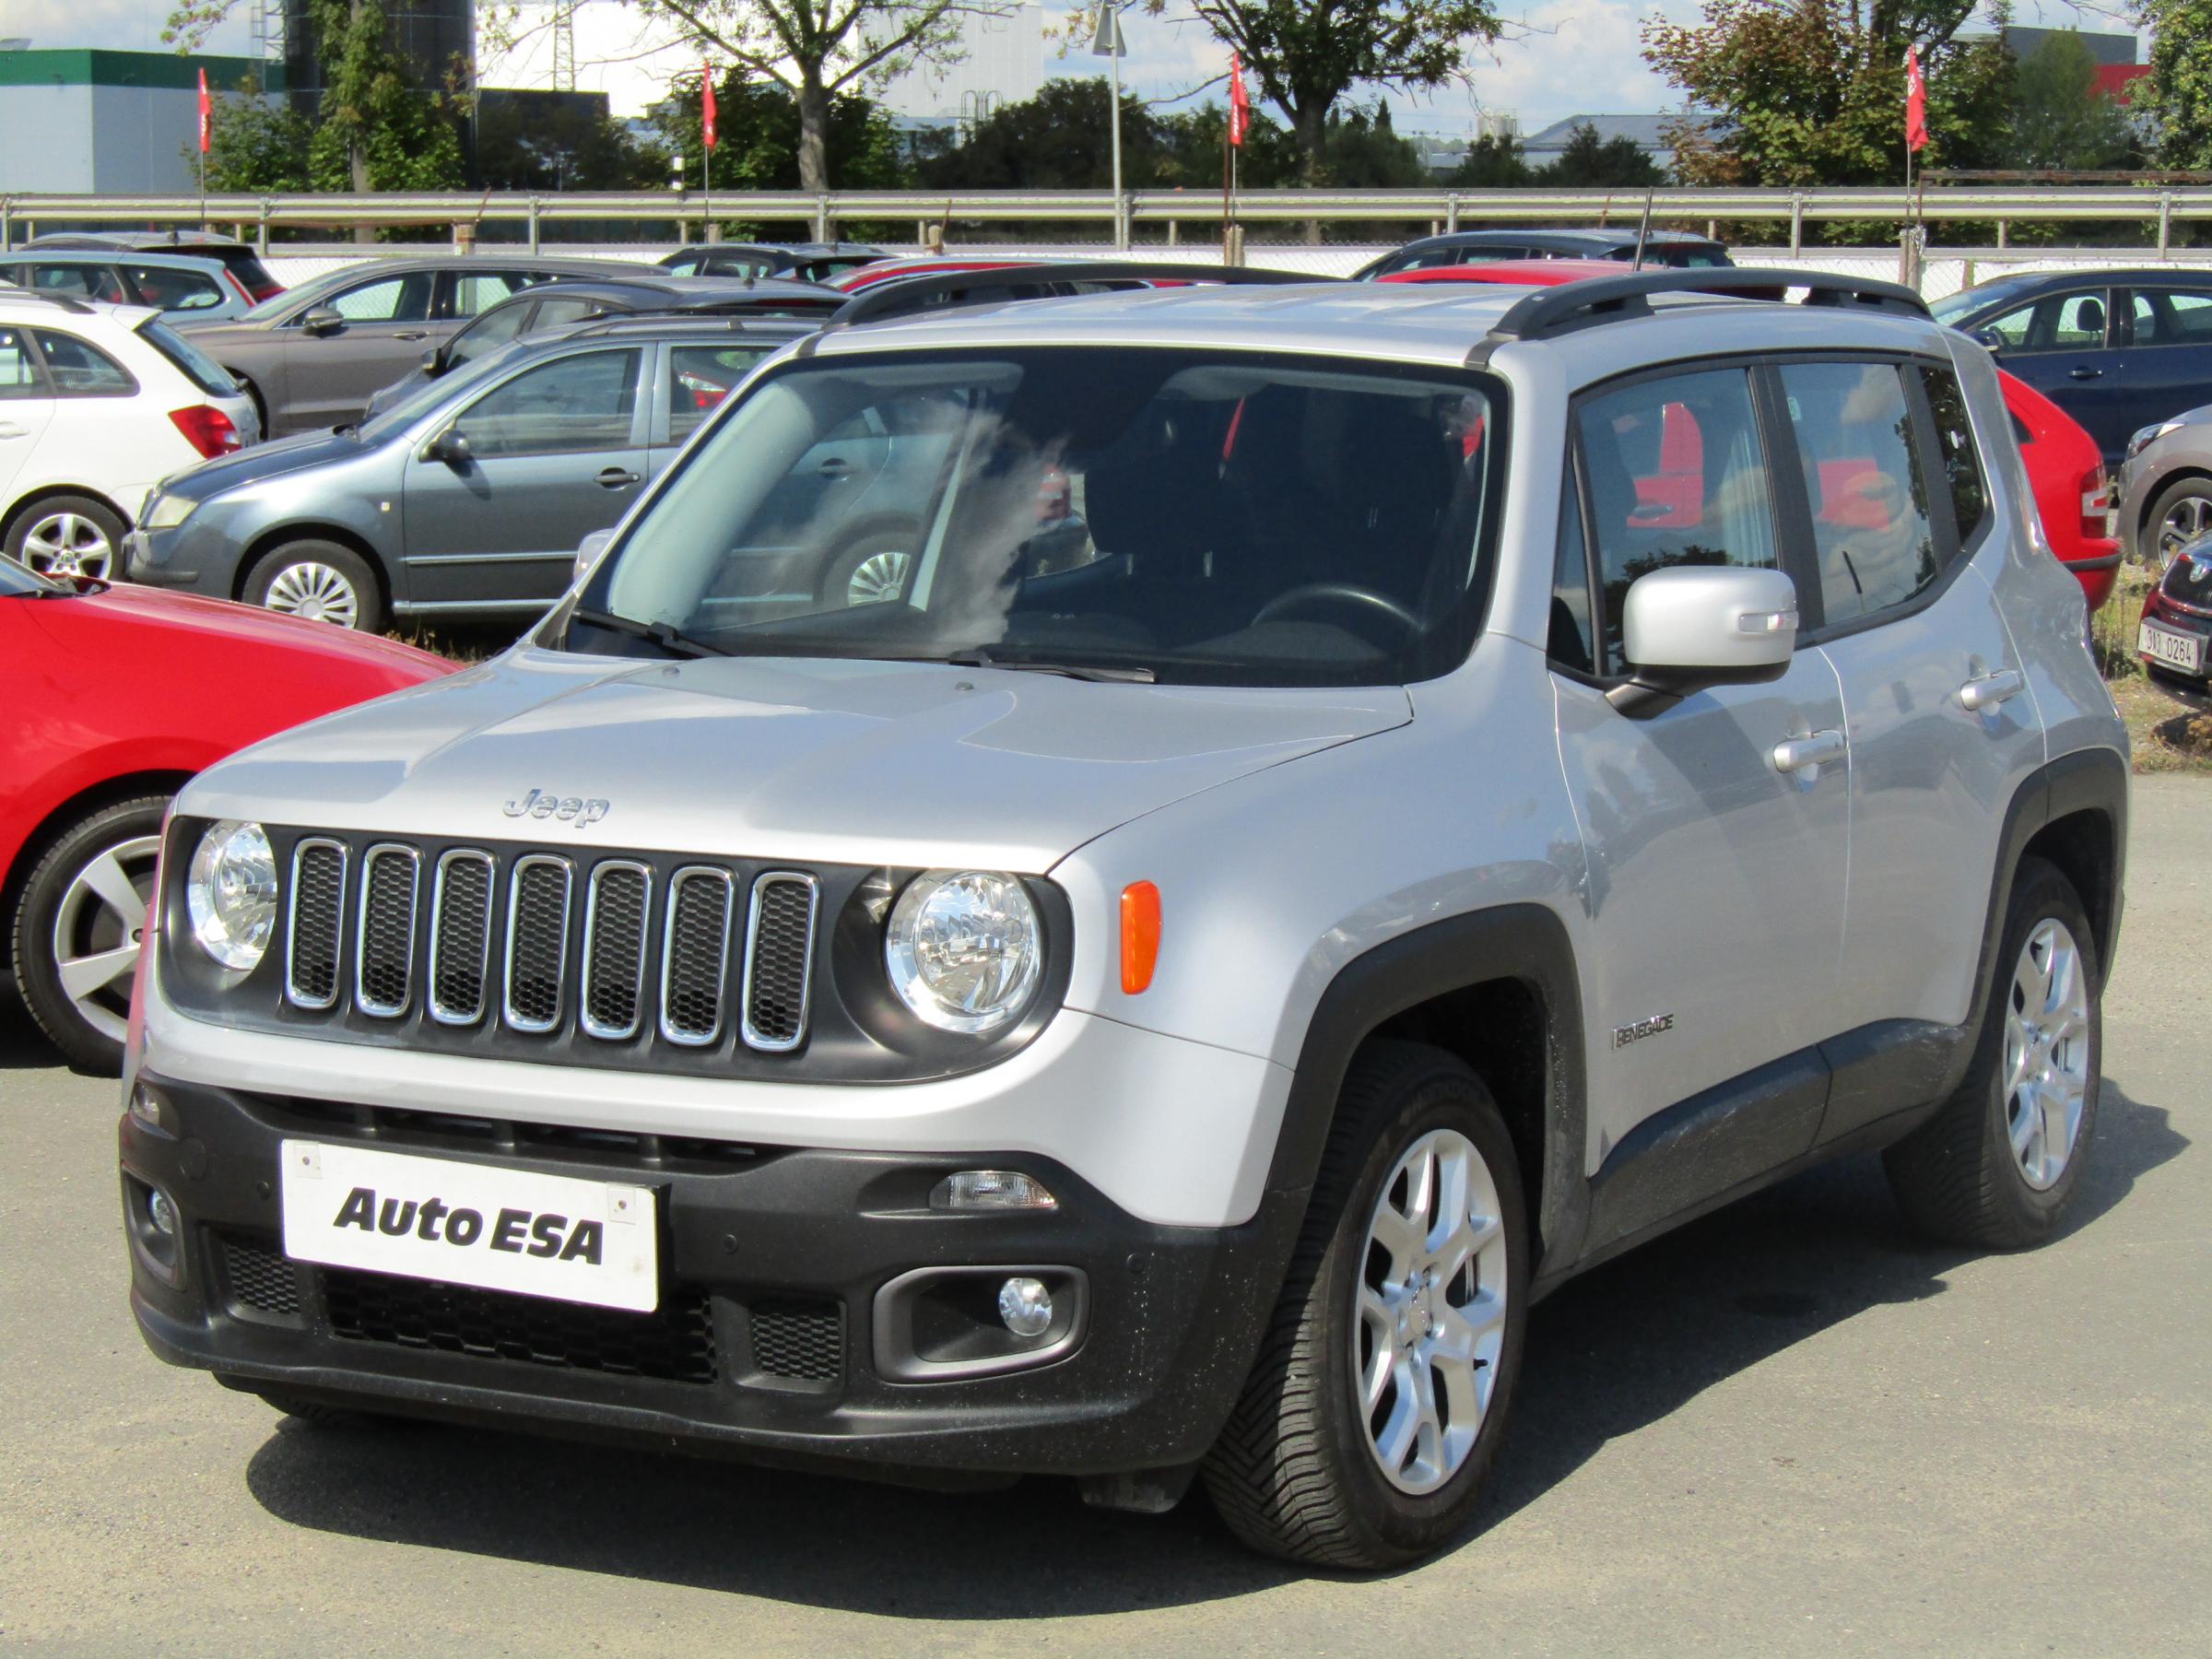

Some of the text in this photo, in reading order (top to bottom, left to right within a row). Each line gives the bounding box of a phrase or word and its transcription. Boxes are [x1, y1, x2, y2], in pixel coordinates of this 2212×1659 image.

[2167, 637, 2191, 664] 0264
[502, 788, 610, 829] Jeep
[1612, 1012, 1674, 1049] RENEGADE
[333, 1186, 604, 1265] Auto ESA
